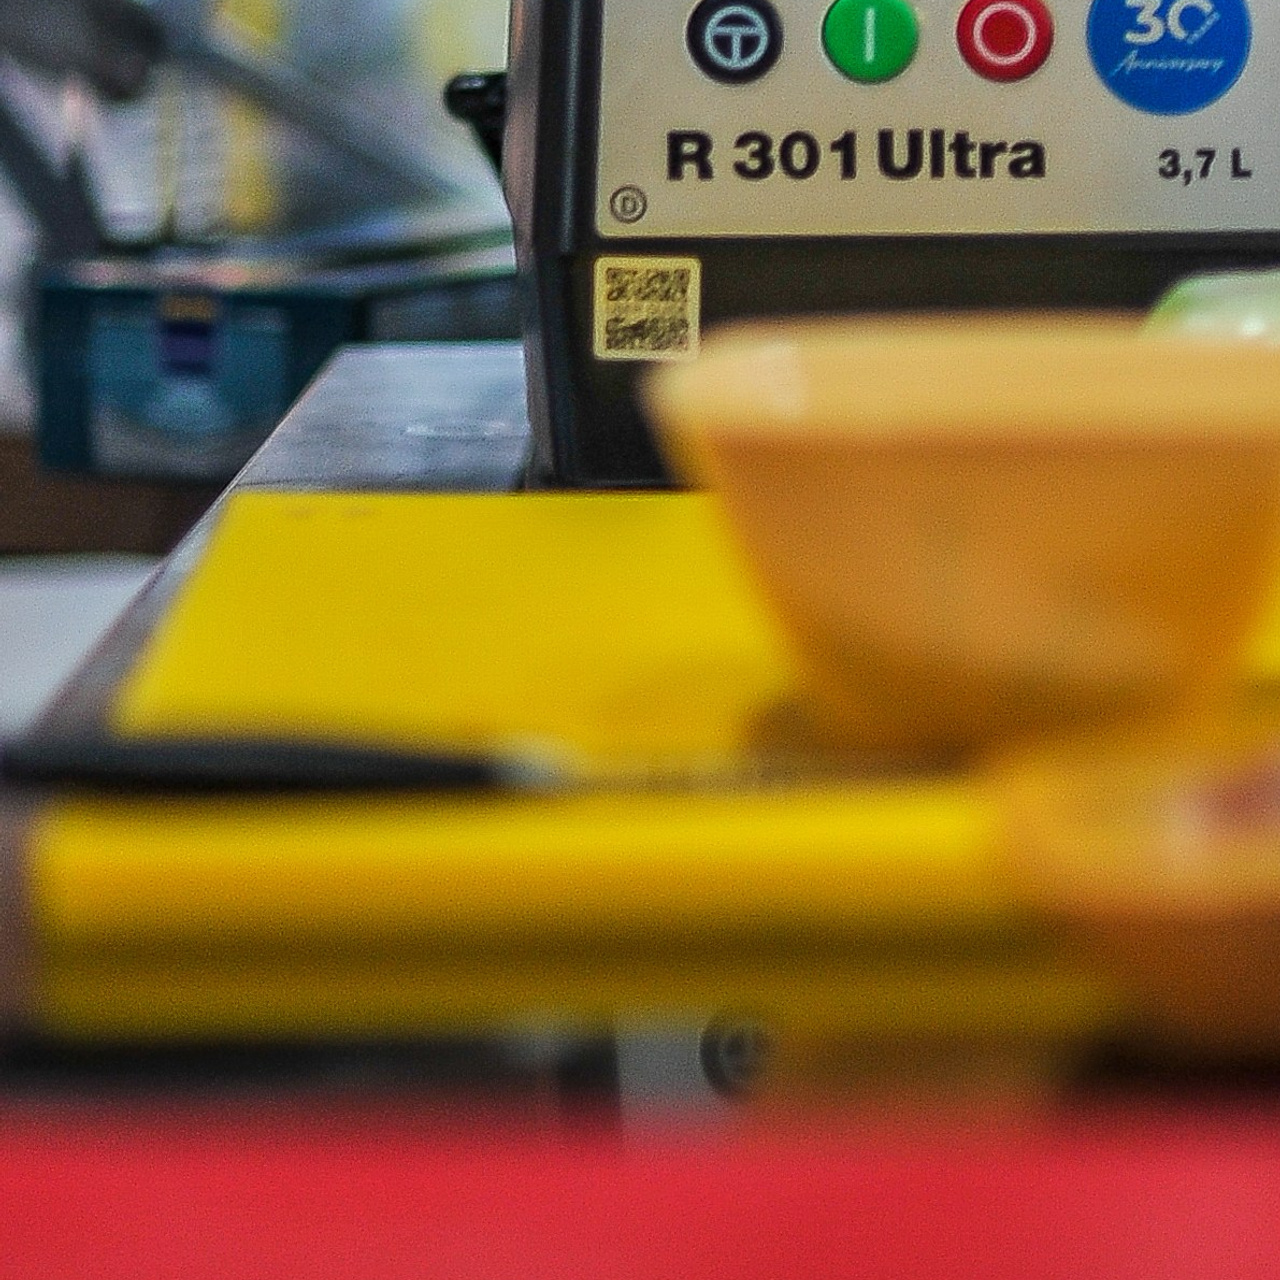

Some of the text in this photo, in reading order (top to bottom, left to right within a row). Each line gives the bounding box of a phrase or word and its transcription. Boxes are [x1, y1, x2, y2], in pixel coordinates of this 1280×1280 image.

[666, 127, 1048, 182] R 301 Ultra
[1156, 149, 1253, 186] 3,7 L
